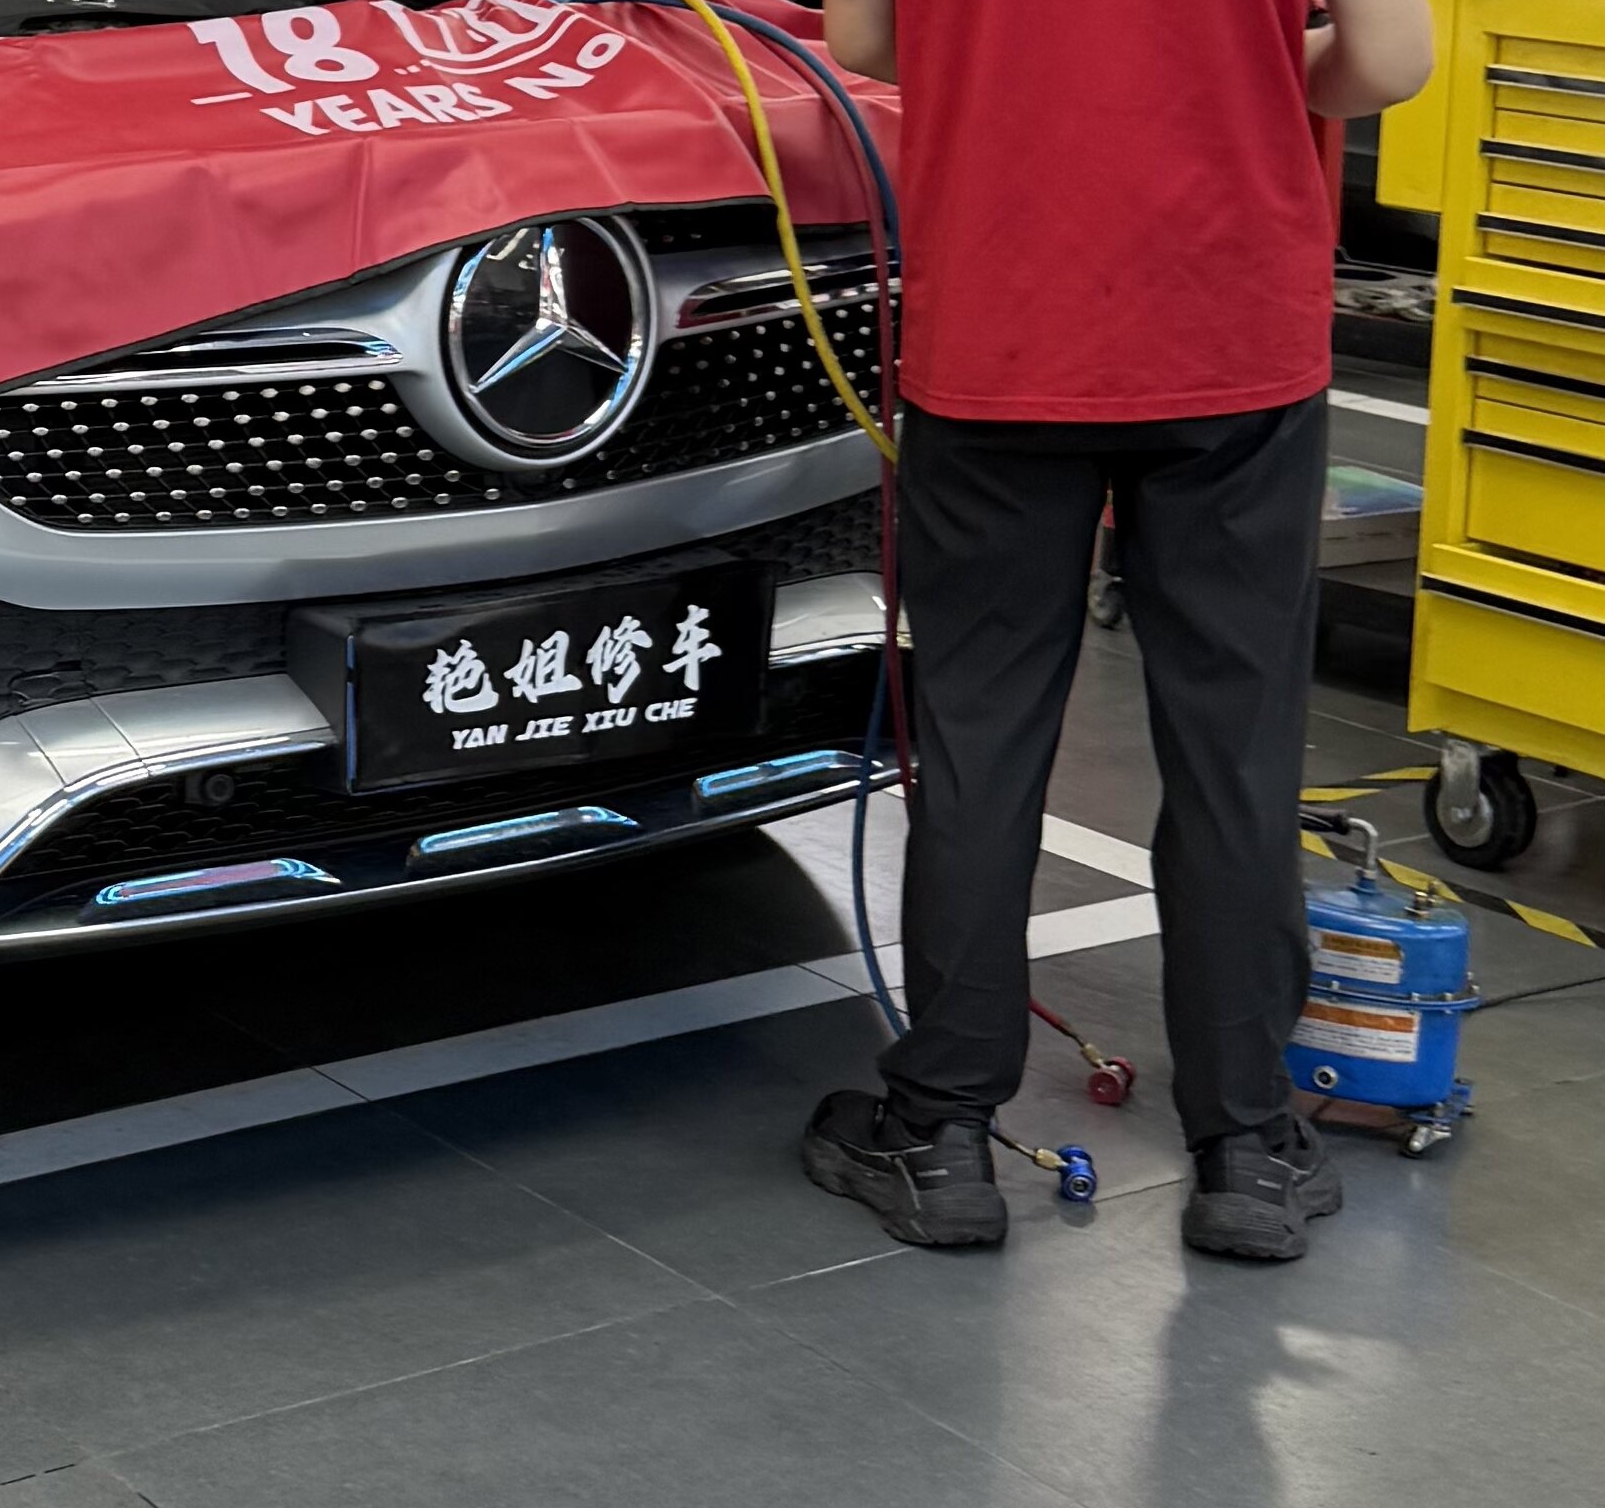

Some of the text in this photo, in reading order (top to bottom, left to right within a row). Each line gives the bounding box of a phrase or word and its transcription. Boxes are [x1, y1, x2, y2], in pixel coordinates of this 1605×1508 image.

[187, 6, 380, 95] 18
[260, 82, 514, 136] YEARS
[423, 604, 723, 714] 艳姐修车
[451, 697, 699, 750] YAN JIE XIU CHE
